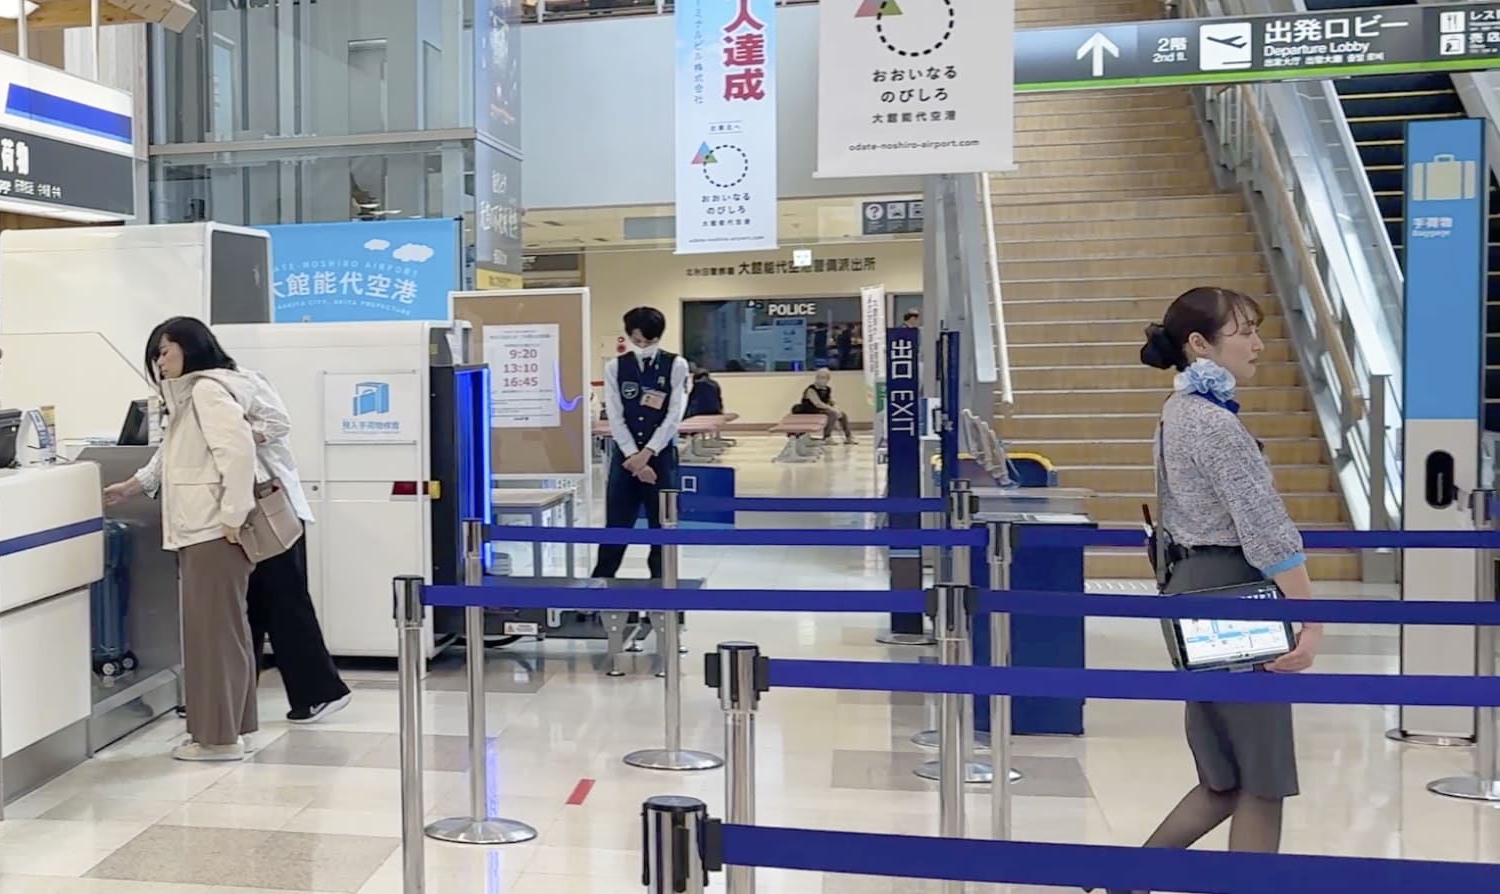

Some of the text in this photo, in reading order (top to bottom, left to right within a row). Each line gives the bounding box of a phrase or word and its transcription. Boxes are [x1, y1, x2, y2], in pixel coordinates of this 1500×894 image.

[1264, 14, 1409, 44] 出発ロビー
[1157, 37, 1188, 52] 2階
[1263, 41, 1370, 58] Departure Lobby
[872, 65, 957, 83] おおいなる
[880, 87, 948, 103] のびしろ
[871, 110, 956, 124] 大館能代空港
[849, 139, 980, 152] odate-noshiro-airport.com
[701, 192, 751, 203] おおいなる
[706, 205, 746, 215] のびしろ
[768, 302, 817, 317] POLICE
[509, 348, 538, 360] 9:20
[503, 363, 539, 374] 13:10
[503, 376, 539, 388] 16:45
[891, 339, 915, 437] 出口 EXIT
